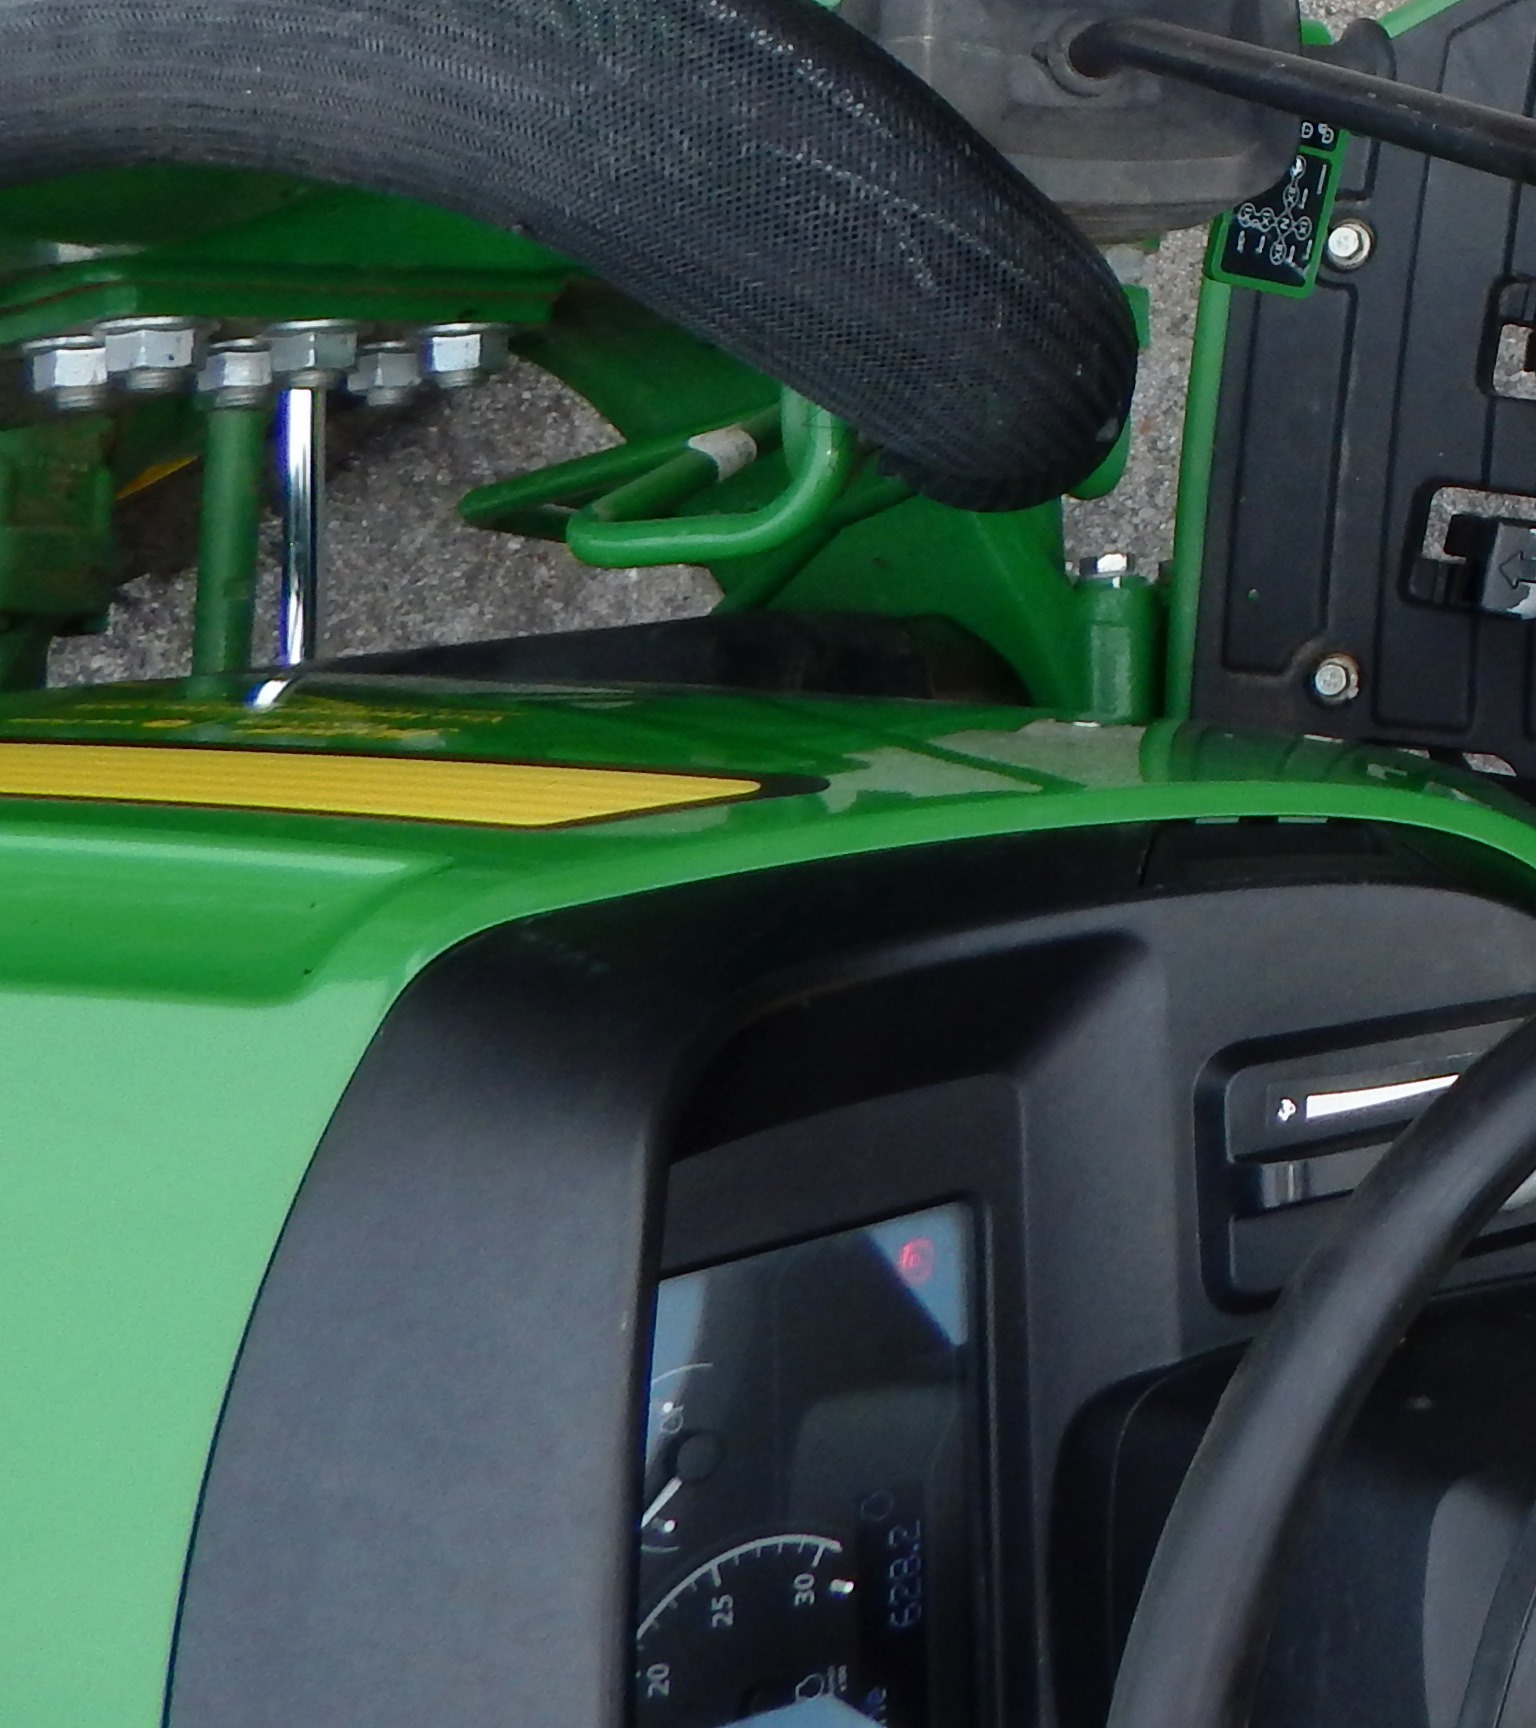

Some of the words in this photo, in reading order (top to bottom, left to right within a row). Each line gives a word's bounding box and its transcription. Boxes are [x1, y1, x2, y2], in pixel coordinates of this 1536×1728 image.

[794, 1572, 816, 1606] 30
[711, 1593, 734, 1629] 25
[647, 1662, 670, 1698] 20
